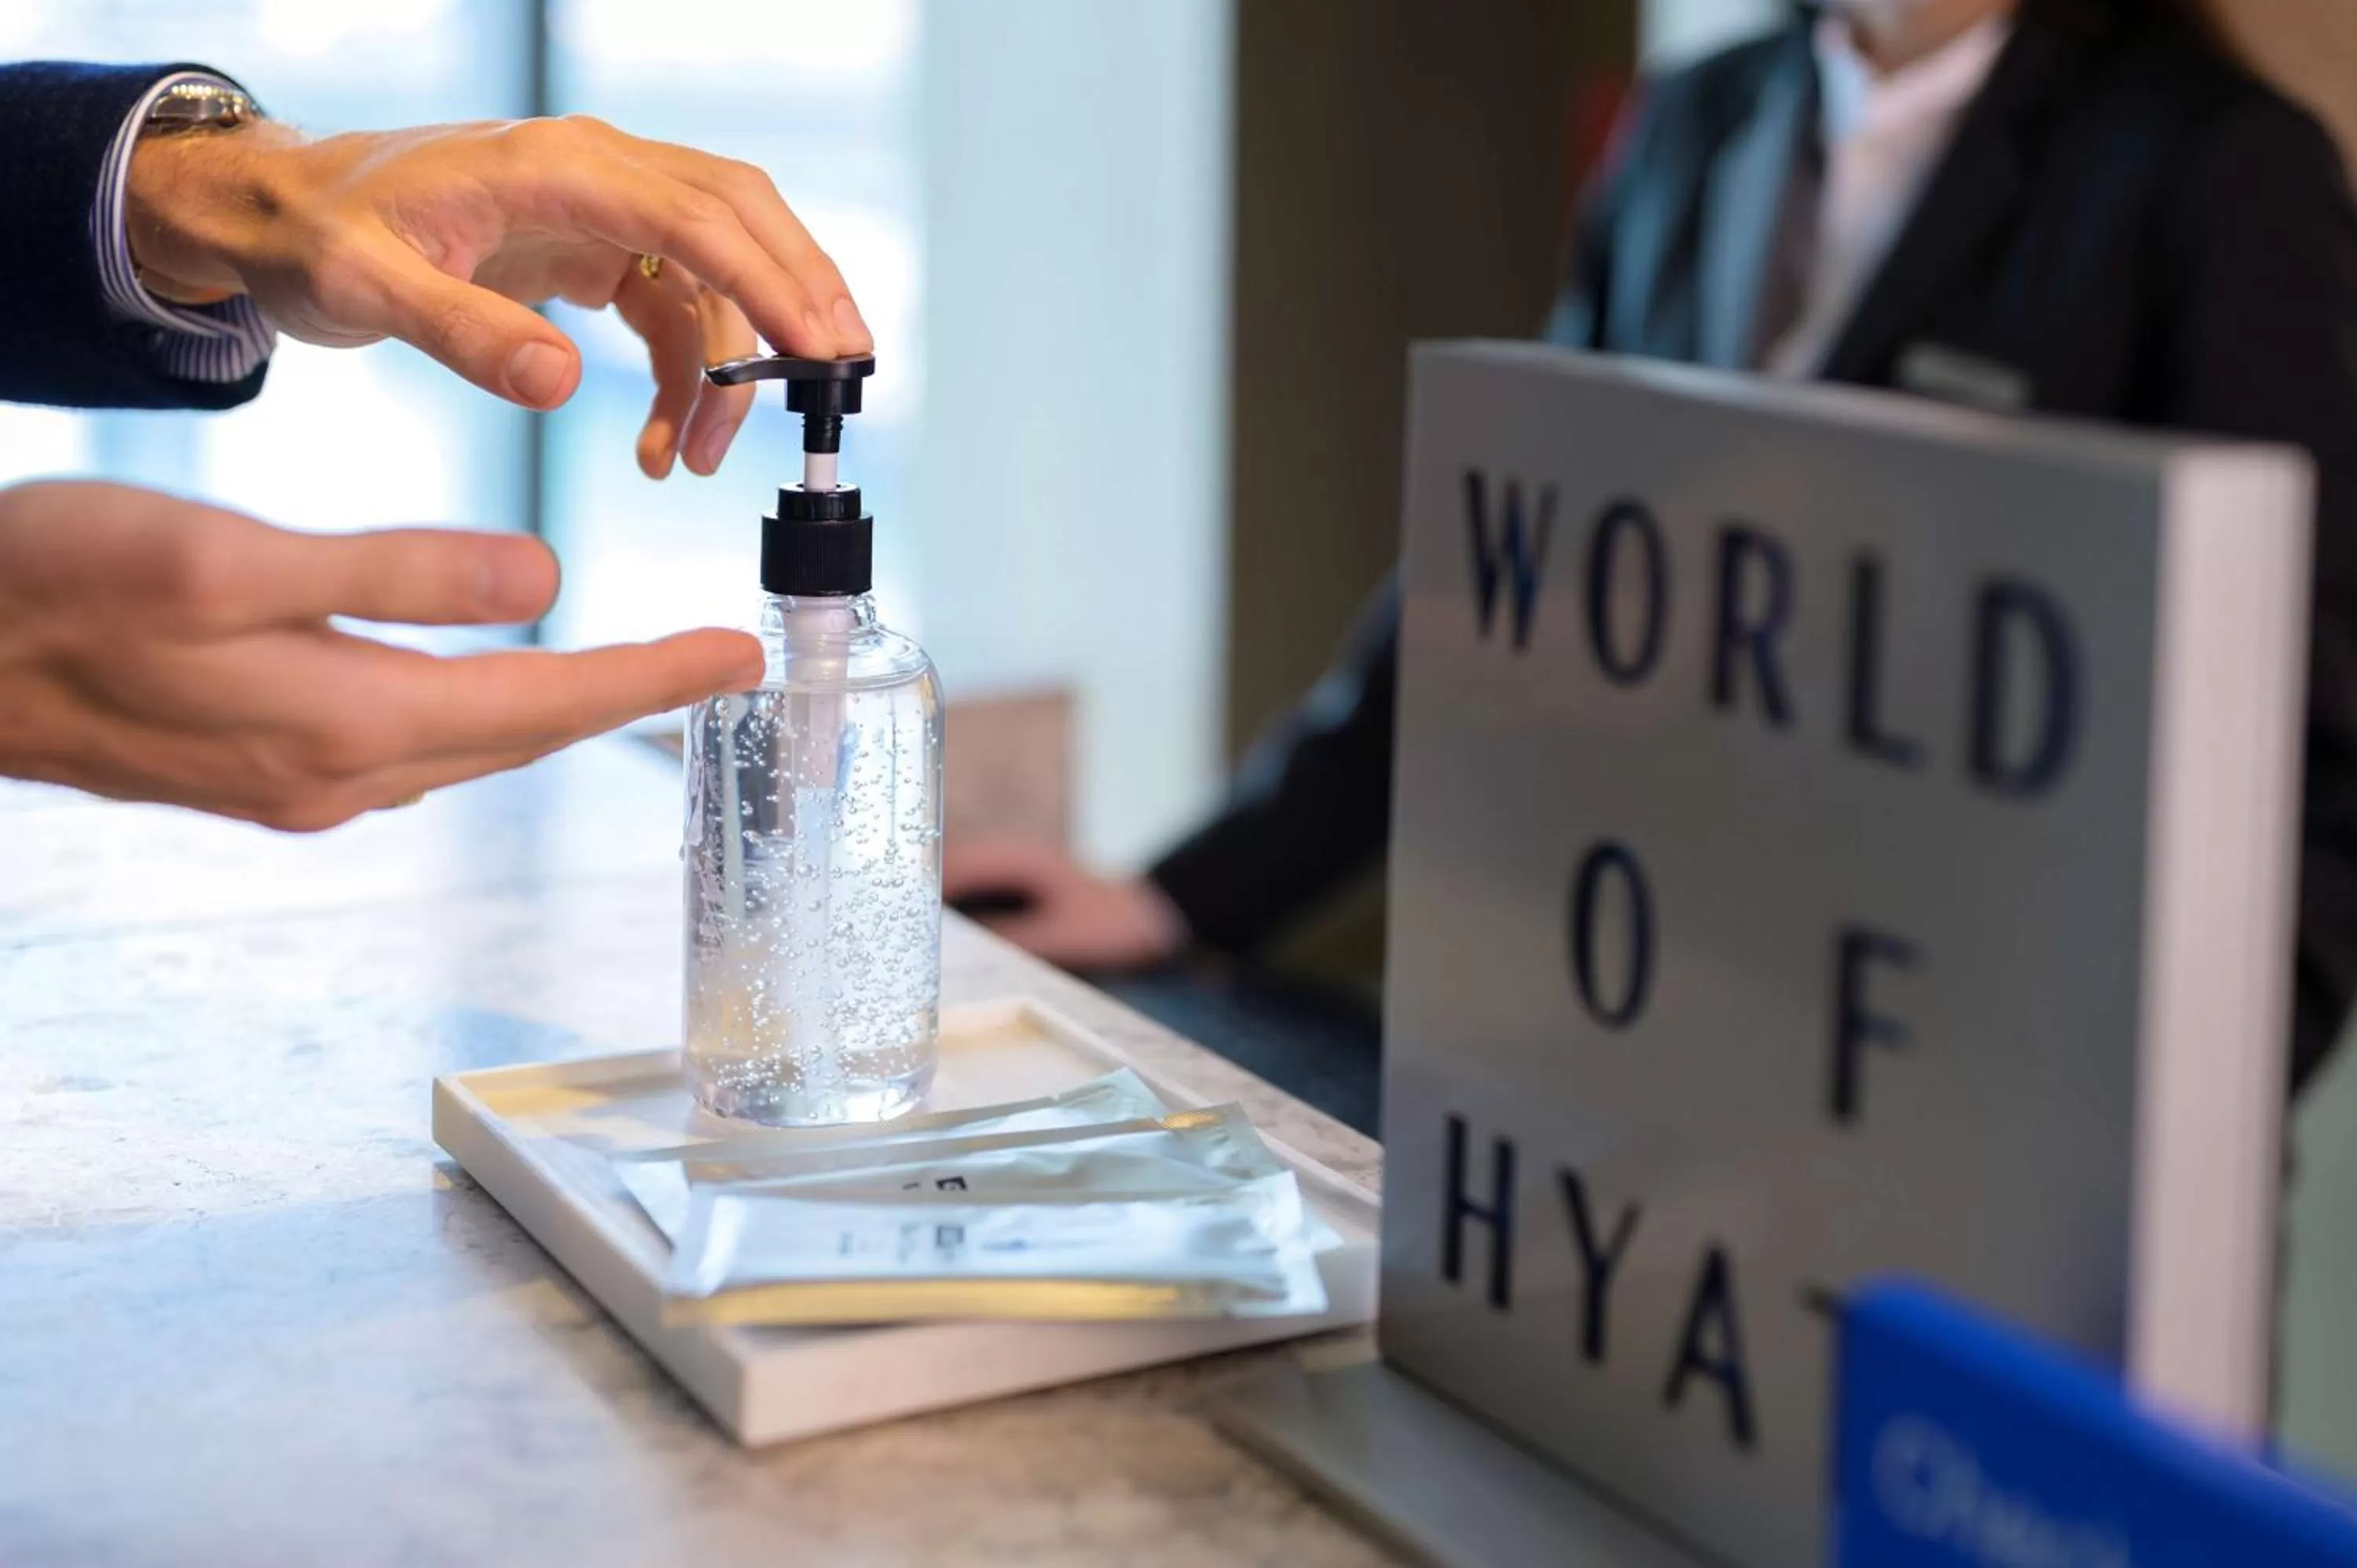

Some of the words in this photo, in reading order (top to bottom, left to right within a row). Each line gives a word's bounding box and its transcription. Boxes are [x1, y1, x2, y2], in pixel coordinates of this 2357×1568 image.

[1461, 467, 2086, 800] WORLD
[1568, 838, 1923, 1125] OF
[1440, 1111, 1837, 1453] HYA
